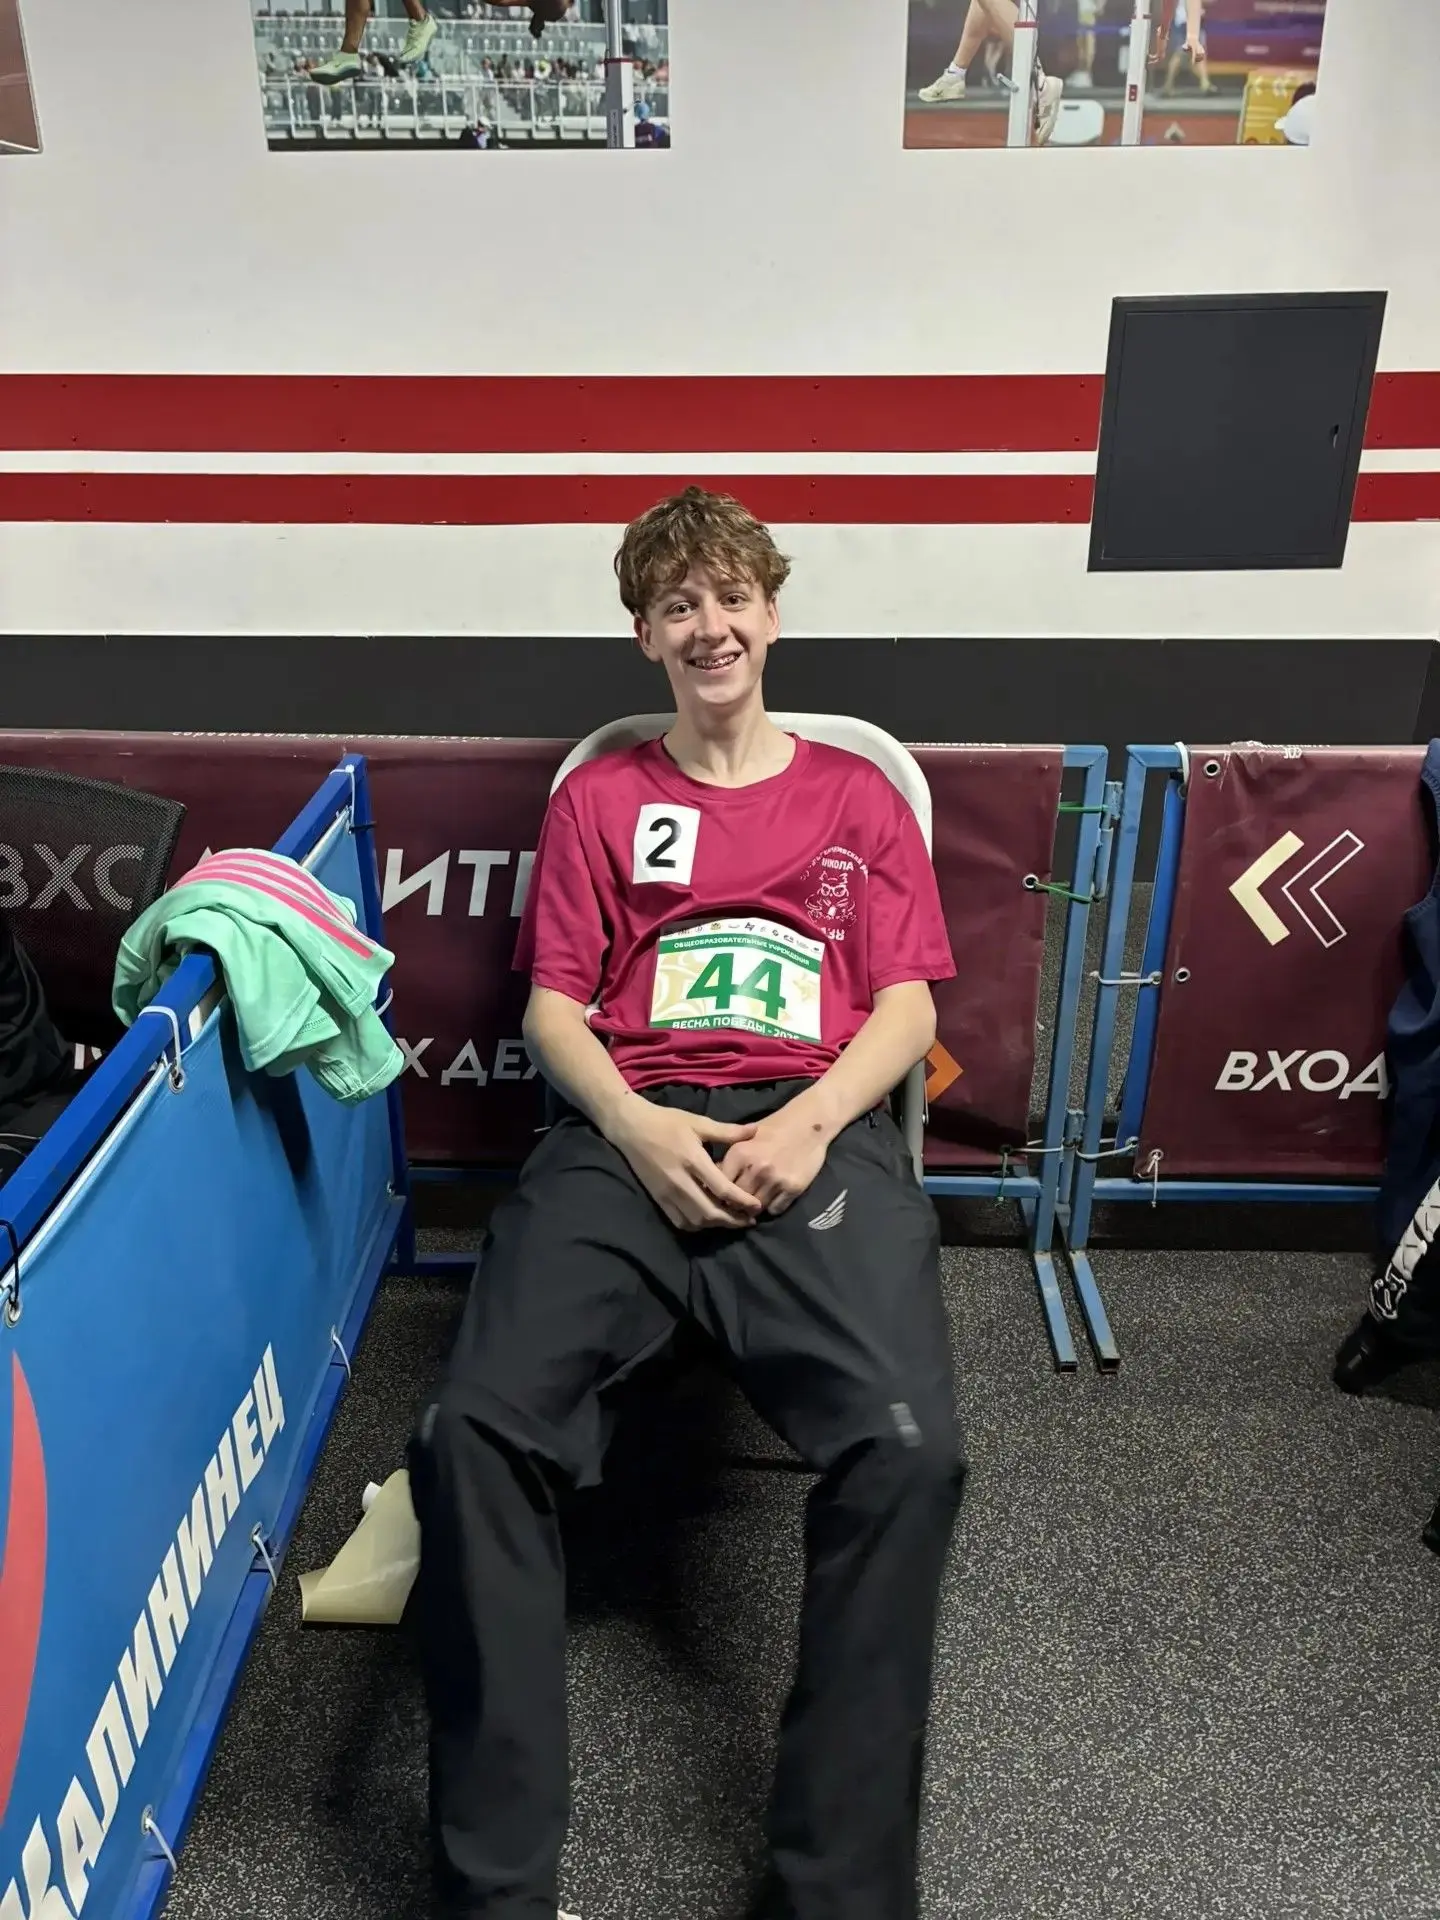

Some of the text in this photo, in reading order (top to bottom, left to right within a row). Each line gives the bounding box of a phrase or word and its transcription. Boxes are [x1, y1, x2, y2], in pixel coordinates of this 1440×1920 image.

[645, 817, 682, 869] 2
[821, 858, 854, 871] ШКОЛА
[674, 936, 810, 966] ОБЩЕОБРАЗОВАТЕЛЬНЫЕ УЧРЕЖДЕНИЯ
[686, 952, 787, 1020] 44
[672, 1019, 710, 1030] ВЕСНА
[713, 1017, 766, 1033] ПОБЕДЫ
[1214, 1050, 1391, 1100] ВХОД
